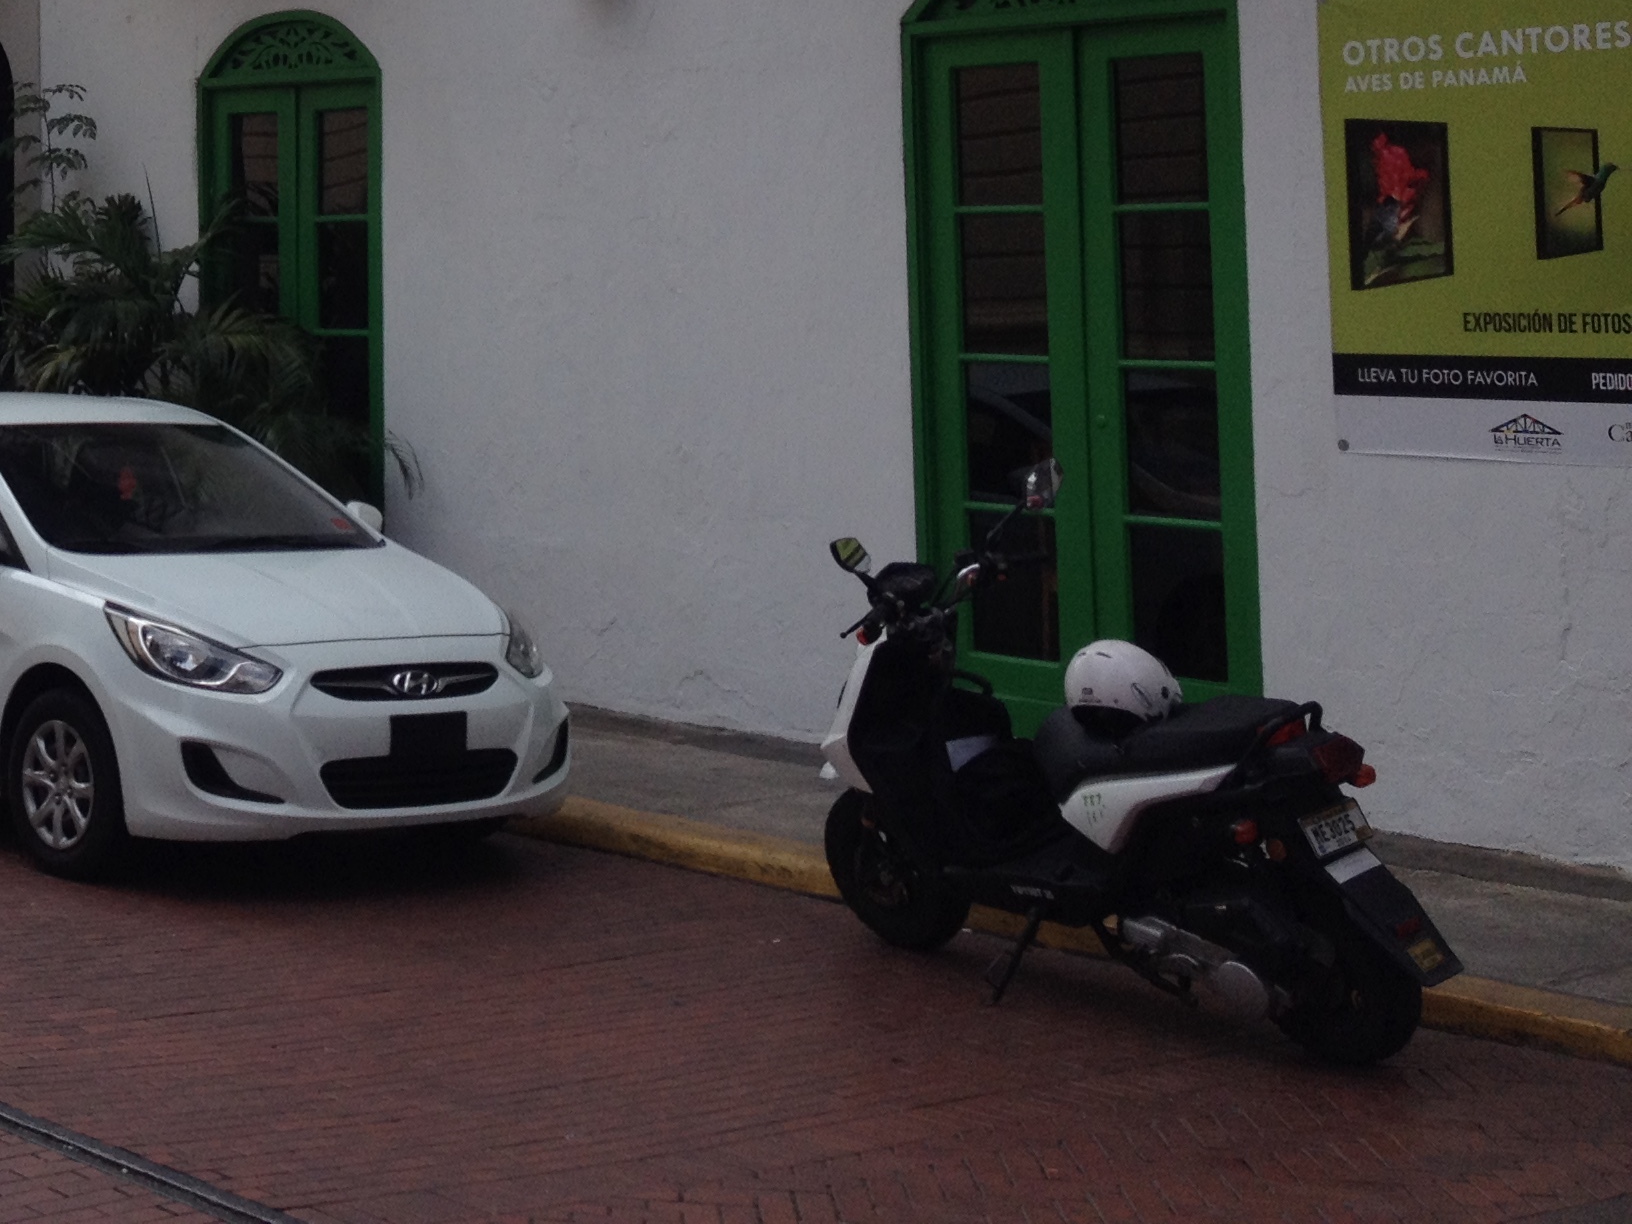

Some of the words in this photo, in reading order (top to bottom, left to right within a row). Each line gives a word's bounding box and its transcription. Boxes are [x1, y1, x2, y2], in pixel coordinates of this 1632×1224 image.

[1342, 34, 1444, 66] OTROS
[1455, 20, 1631, 59] CANTORES
[1344, 73, 1393, 93] AVES
[1399, 71, 1424, 90] DE
[1432, 61, 1527, 88] PANAMÁ
[1463, 309, 1553, 333] EXPOSICIÓN
[1558, 312, 1578, 334] DE
[1582, 312, 1632, 335] FOTOS
[1358, 367, 1396, 383] LLEVA
[1400, 369, 1418, 384] TU
[1422, 369, 1463, 385] FOTO
[1467, 370, 1538, 387] FAVORITA
[1505, 434, 1561, 447] HUERTA
